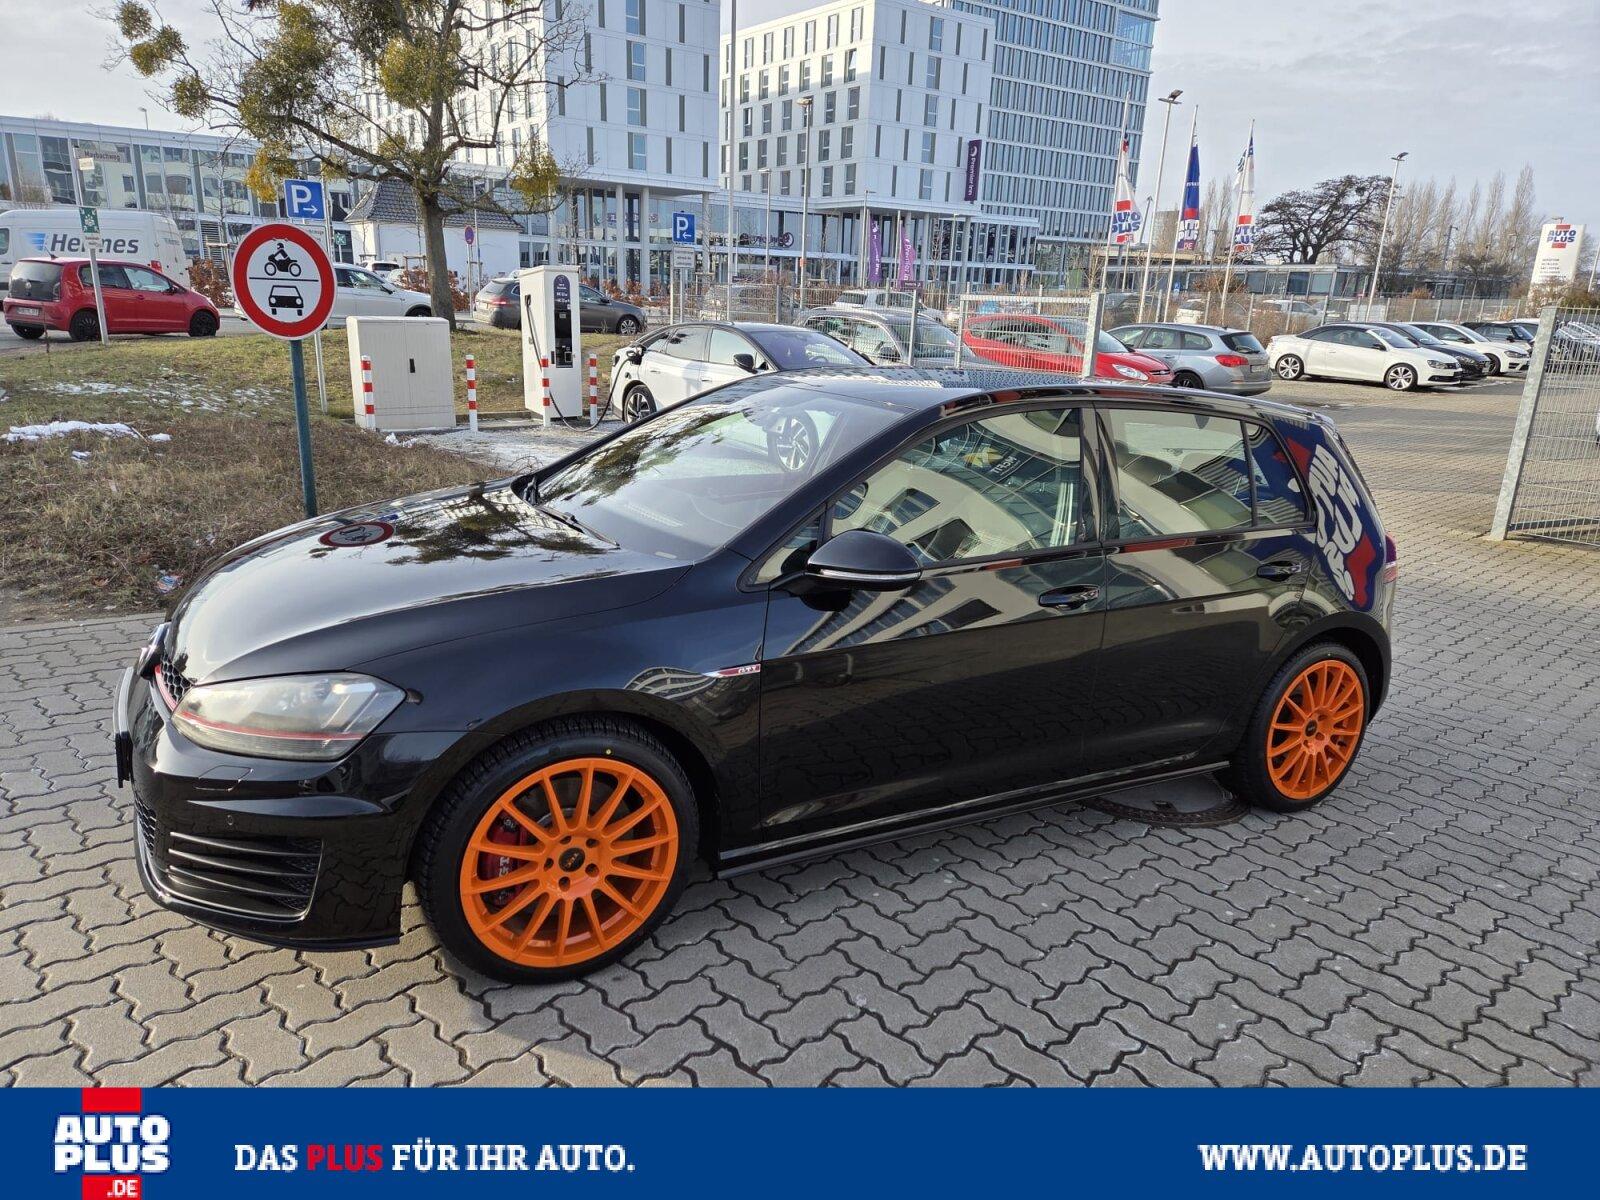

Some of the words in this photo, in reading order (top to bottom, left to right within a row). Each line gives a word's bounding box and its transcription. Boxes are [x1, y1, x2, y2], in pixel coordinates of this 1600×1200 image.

[291, 184, 312, 214] P
[677, 216, 689, 239] P
[904, 244, 912, 273] Premier
